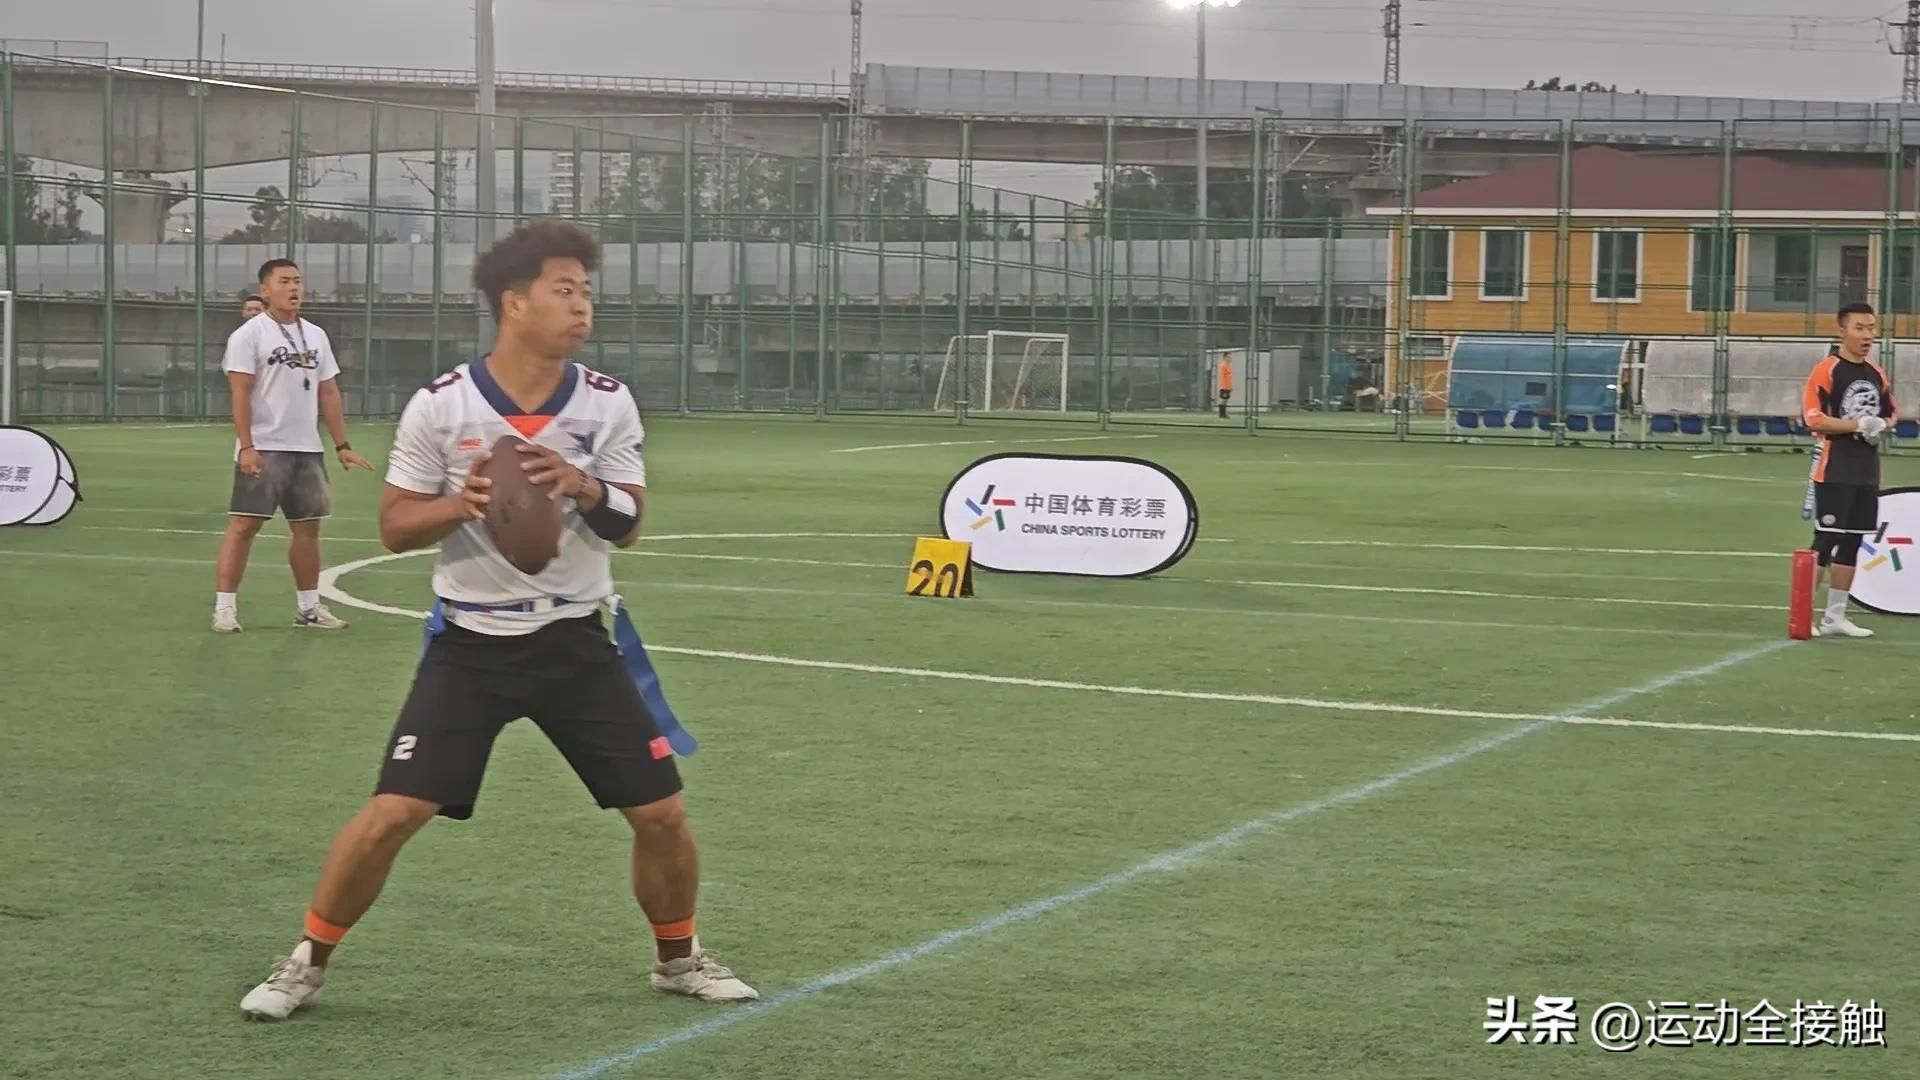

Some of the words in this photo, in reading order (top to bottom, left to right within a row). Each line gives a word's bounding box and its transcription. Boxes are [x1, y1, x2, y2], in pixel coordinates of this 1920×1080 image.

[1024, 493, 1167, 519] 中国体育彩票
[1021, 523, 1058, 535] CHINA
[1060, 525, 1109, 538] SPORTS
[1111, 528, 1166, 540] LOTTERY
[911, 559, 959, 598] 20
[392, 734, 418, 760] 2
